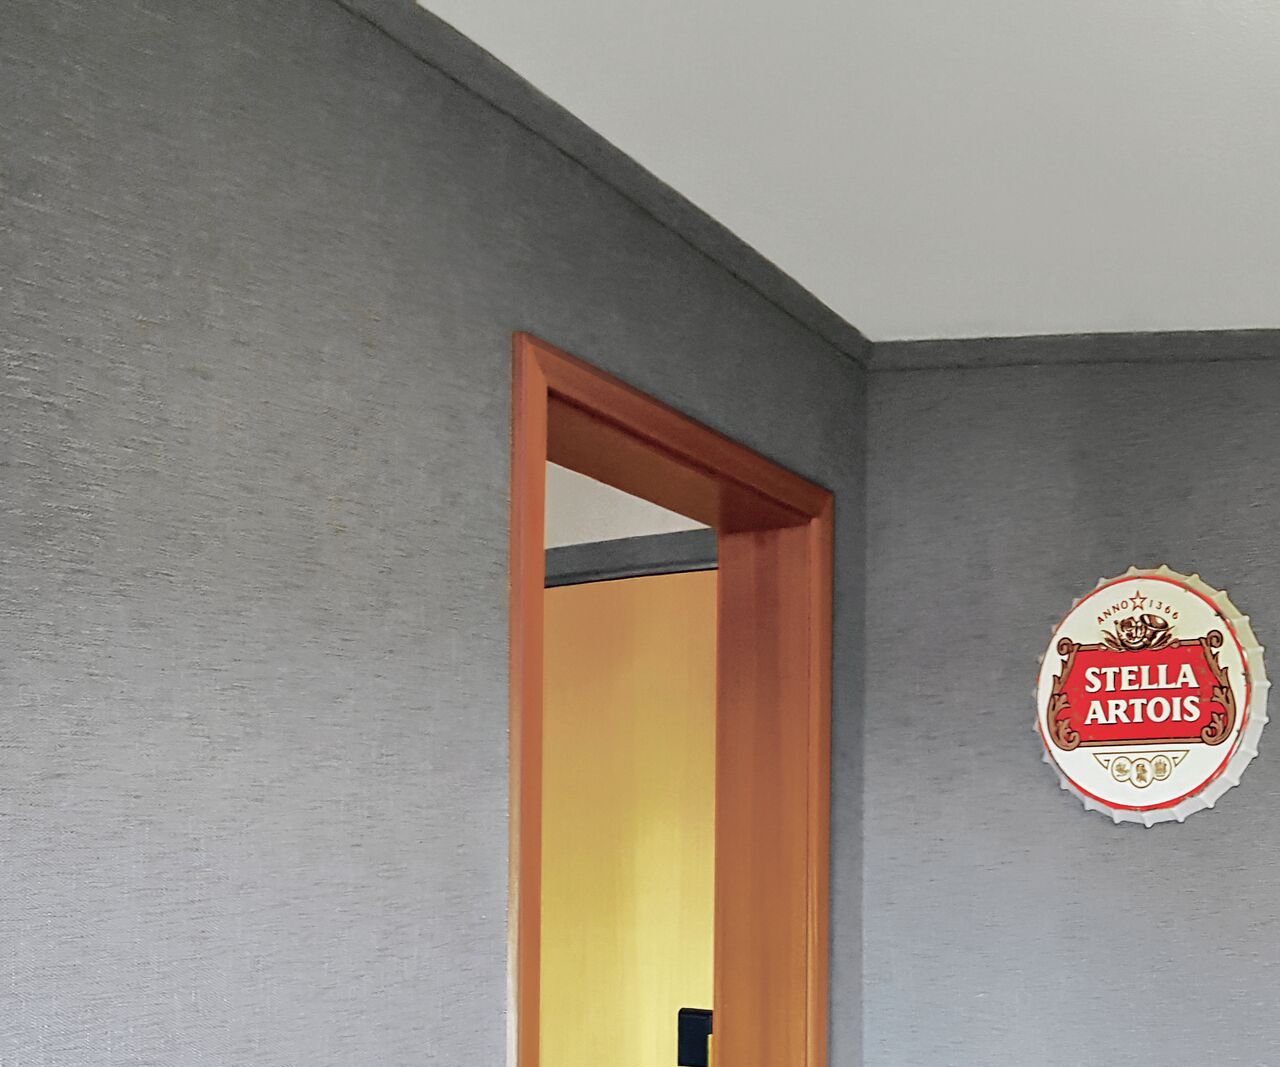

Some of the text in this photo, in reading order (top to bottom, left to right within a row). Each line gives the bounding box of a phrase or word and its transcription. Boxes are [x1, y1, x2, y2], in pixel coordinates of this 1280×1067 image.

[1097, 600, 1179, 625] ANNO 1366
[1084, 664, 1200, 693] STELLA
[1084, 695, 1202, 725] ARTOIS
